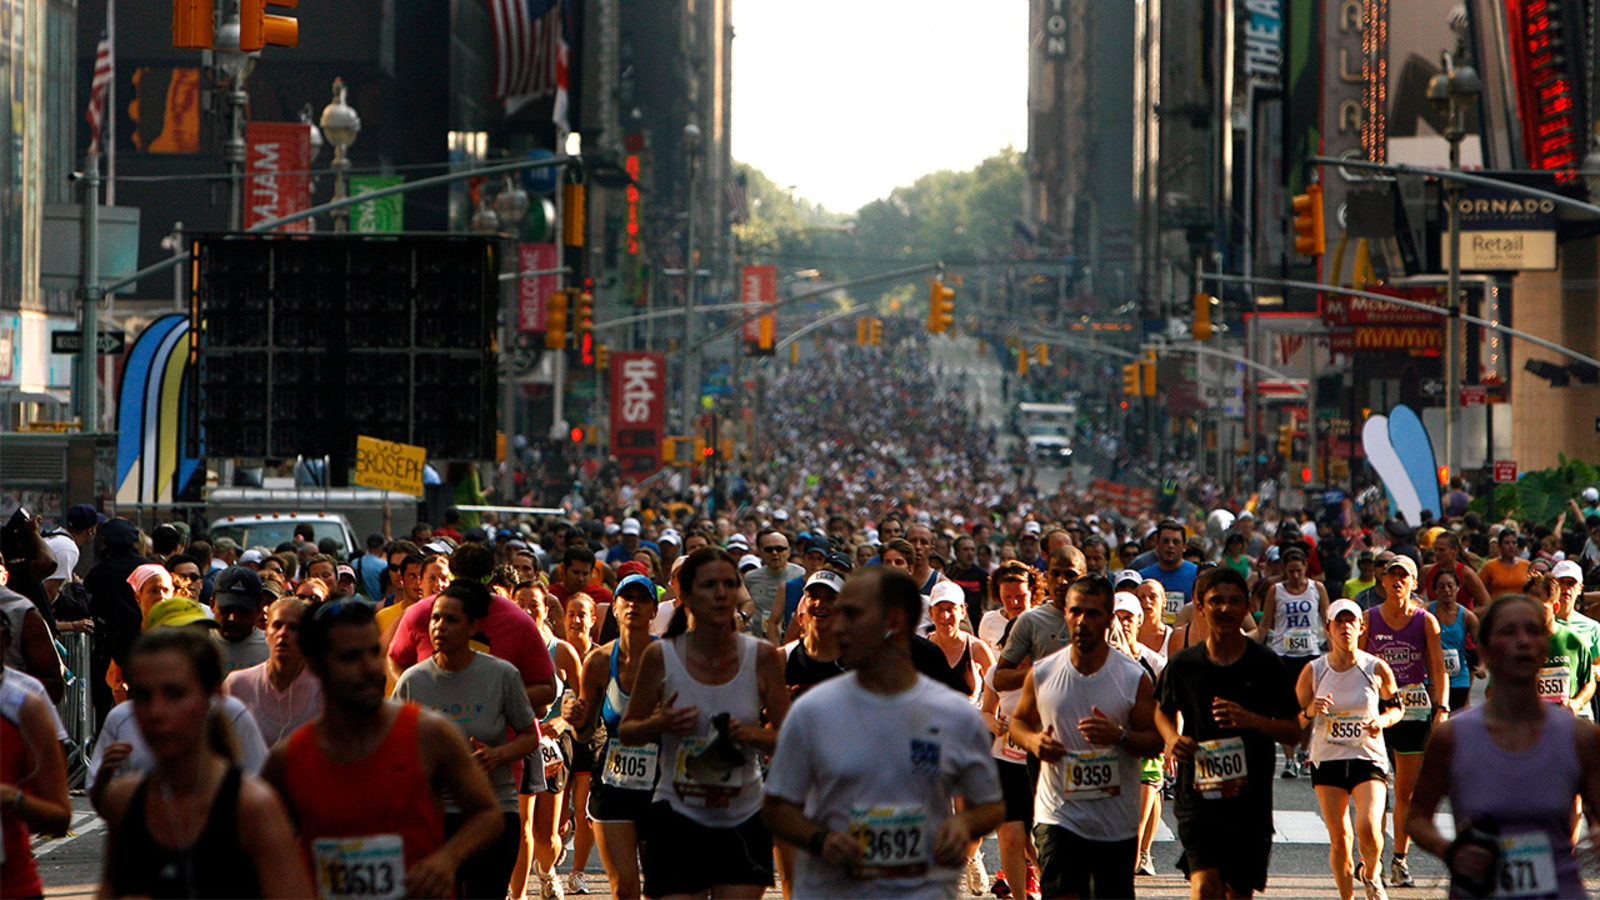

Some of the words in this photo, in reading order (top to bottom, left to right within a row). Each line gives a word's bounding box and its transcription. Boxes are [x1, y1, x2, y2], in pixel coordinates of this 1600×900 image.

[253, 143, 280, 238] MJAM
[1472, 233, 1524, 252] Retail
[522, 249, 540, 329] WELCOME
[1350, 296, 1448, 312] McDold's
[623, 357, 657, 423] tkts
[376, 441, 402, 454] GO
[356, 449, 425, 482] BROSEPH
[1166, 601, 1178, 612] 12
[1285, 600, 1312, 615] HO
[1286, 614, 1312, 628] HA
[1289, 637, 1308, 649] 8541
[1537, 679, 1563, 694] 6551
[1405, 692, 1428, 707] 5449
[1331, 722, 1361, 738] 8556
[542, 745, 558, 762] 84
[613, 755, 647, 778] 8105
[1199, 753, 1242, 779] 10560
[1073, 764, 1112, 786] 9359
